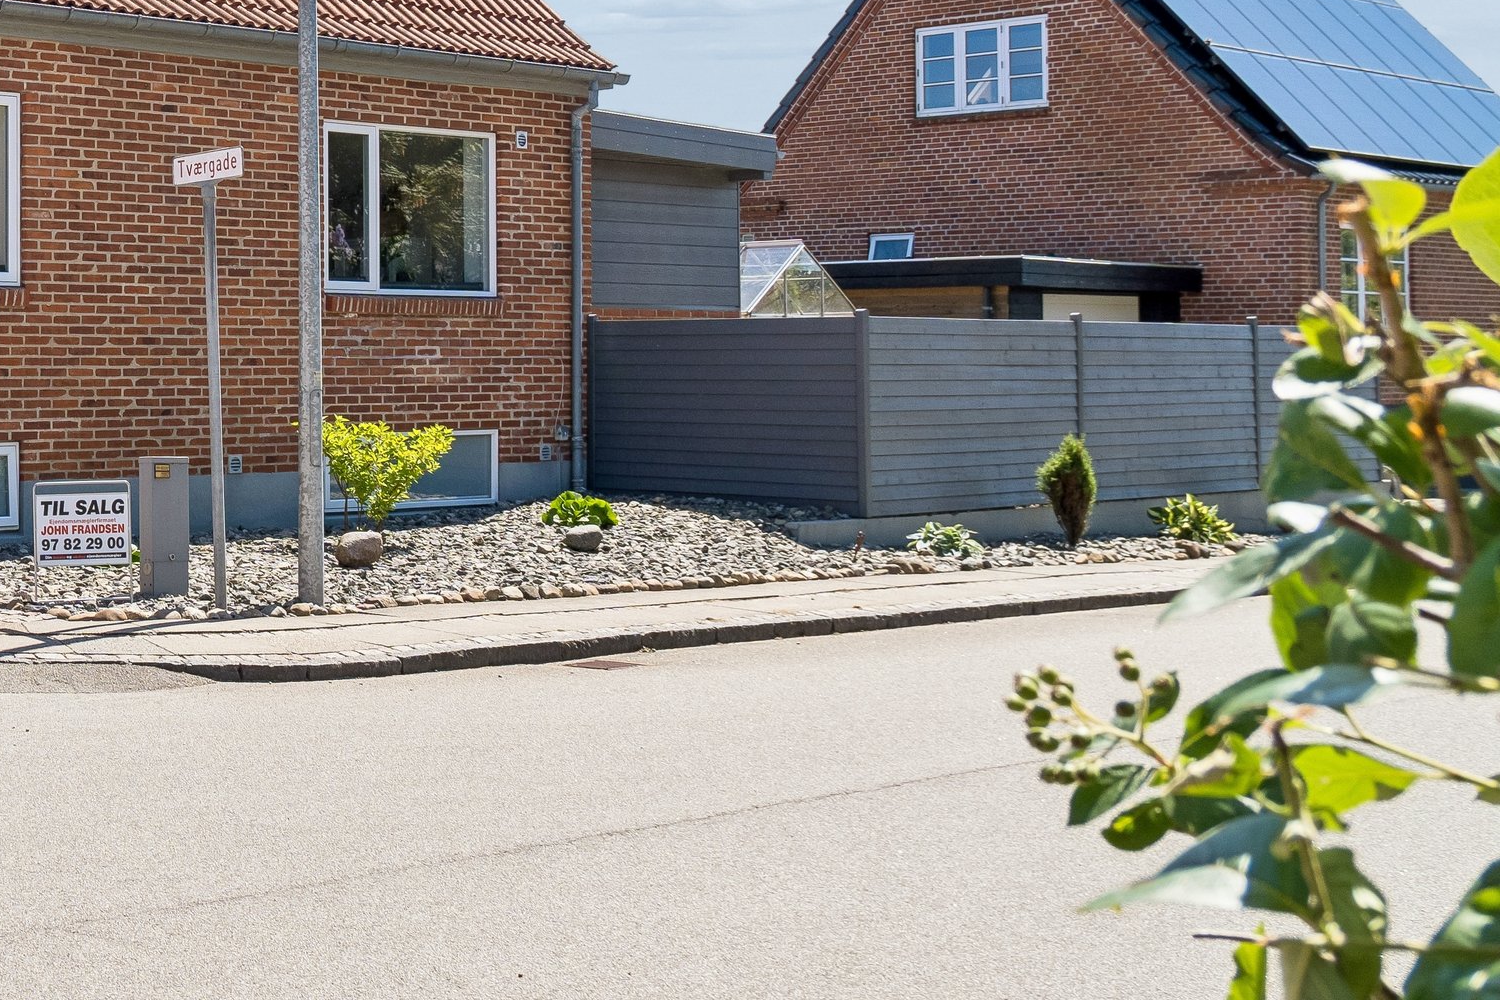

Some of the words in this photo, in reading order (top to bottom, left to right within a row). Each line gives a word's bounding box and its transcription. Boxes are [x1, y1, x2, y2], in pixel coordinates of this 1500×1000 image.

[178, 152, 237, 178] Tværgade
[41, 501, 69, 516] TIL
[75, 499, 125, 515] SALG
[41, 525, 69, 535] JOHN
[72, 523, 125, 534] FRANDSEN
[41, 539, 59, 550] 97
[63, 538, 81, 550] 82
[86, 537, 103, 549] 29
[107, 537, 125, 548] 00
